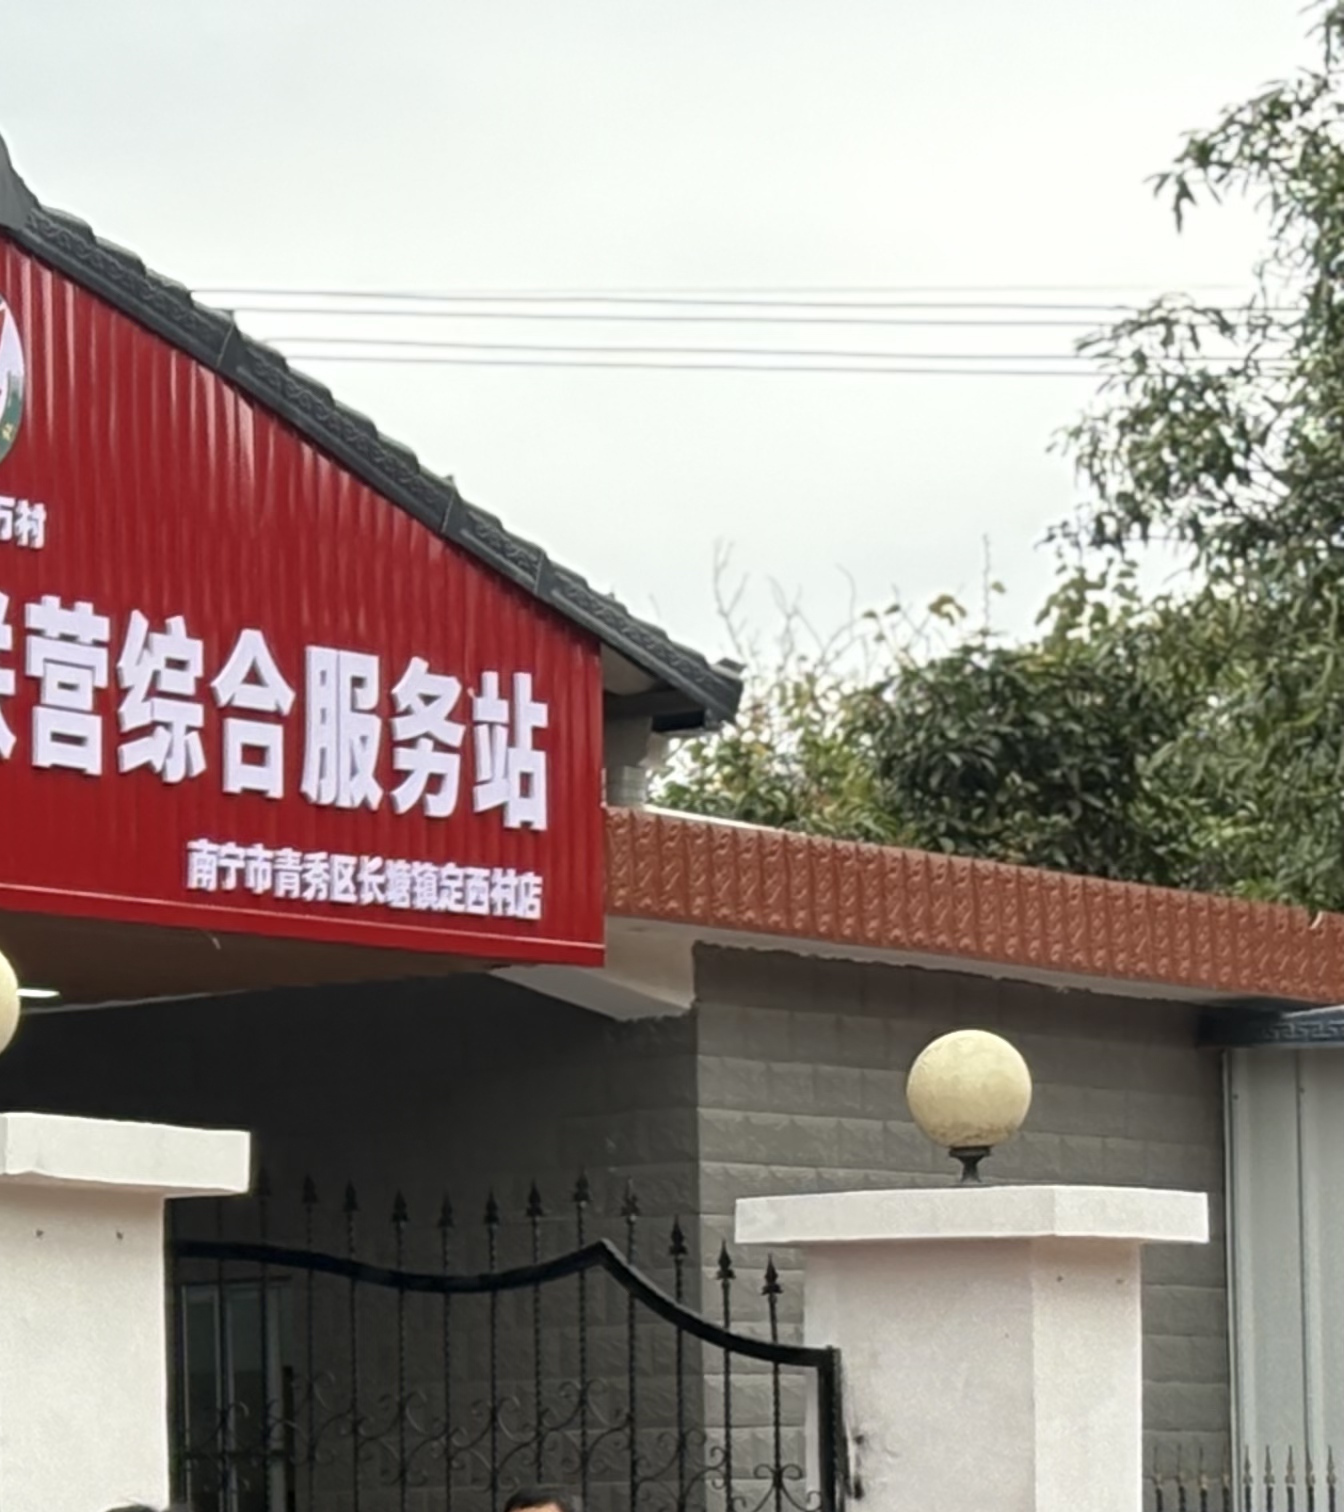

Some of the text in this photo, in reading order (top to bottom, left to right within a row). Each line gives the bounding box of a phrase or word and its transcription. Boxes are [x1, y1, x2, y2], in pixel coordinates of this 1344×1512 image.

[187, 839, 543, 920] 南宁市青秀区长塘镇定西村店
